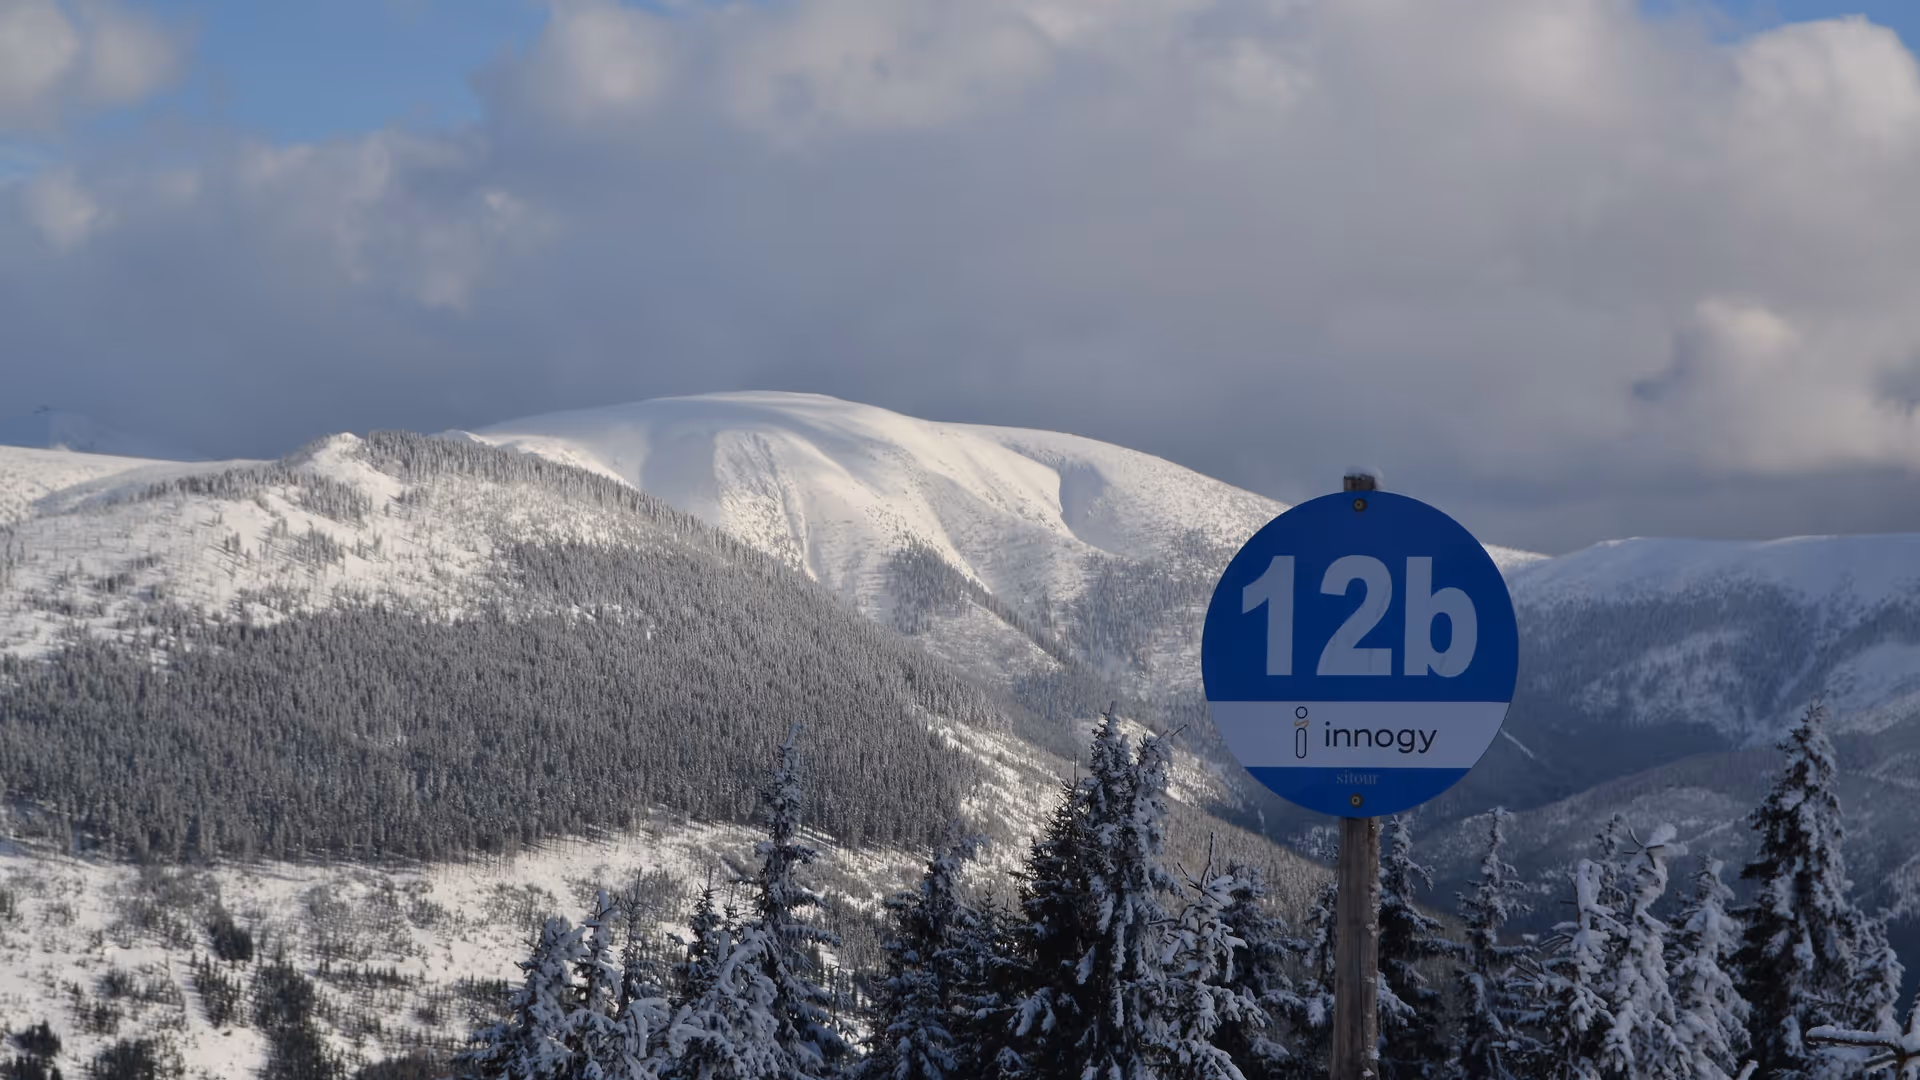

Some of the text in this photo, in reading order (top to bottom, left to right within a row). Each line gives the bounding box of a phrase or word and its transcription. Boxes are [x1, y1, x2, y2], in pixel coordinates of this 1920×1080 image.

[1241, 554, 1478, 678] 12b
[1325, 721, 1438, 754] innogy
[1336, 769, 1380, 785] sitour
